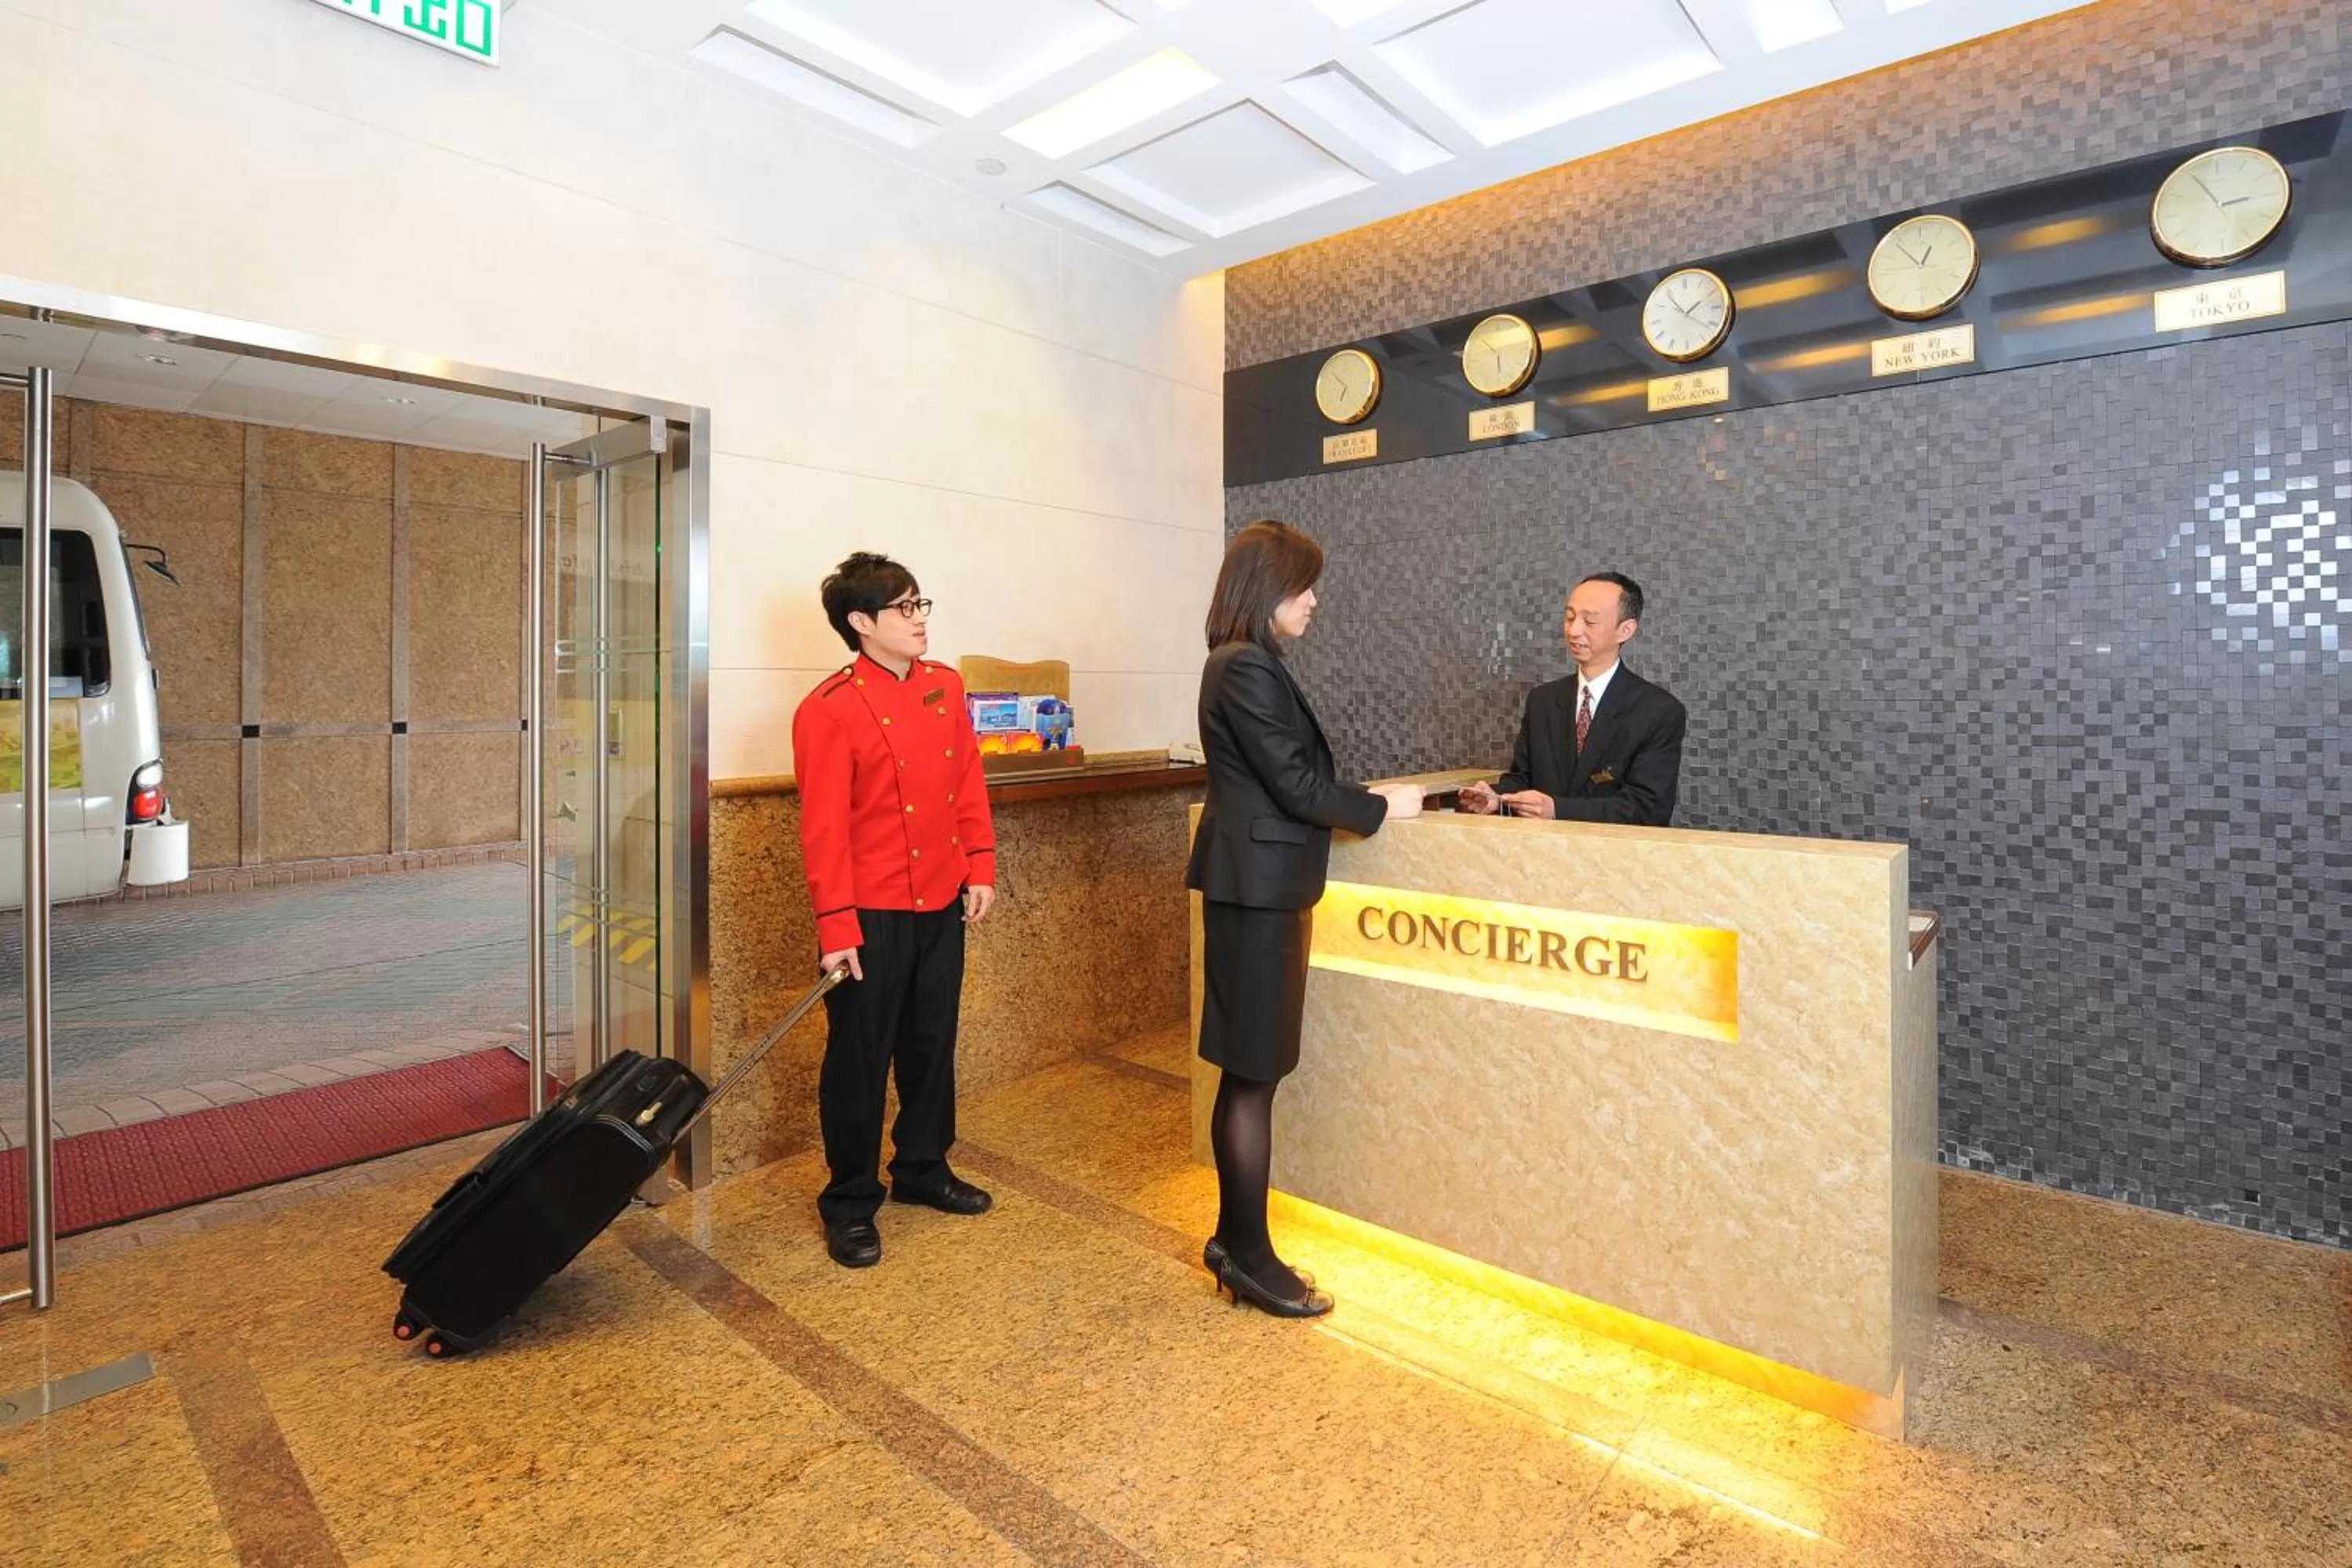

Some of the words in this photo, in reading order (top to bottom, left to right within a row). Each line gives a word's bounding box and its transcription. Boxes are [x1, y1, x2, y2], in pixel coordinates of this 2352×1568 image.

[2188, 300, 2250, 320] TOKYO
[1884, 355, 1915, 368] NEW
[1921, 347, 1961, 363] YORK
[1656, 391, 1688, 405] HONG
[1689, 387, 1719, 401] KONG
[1356, 905, 1649, 983] CONCIERGE
